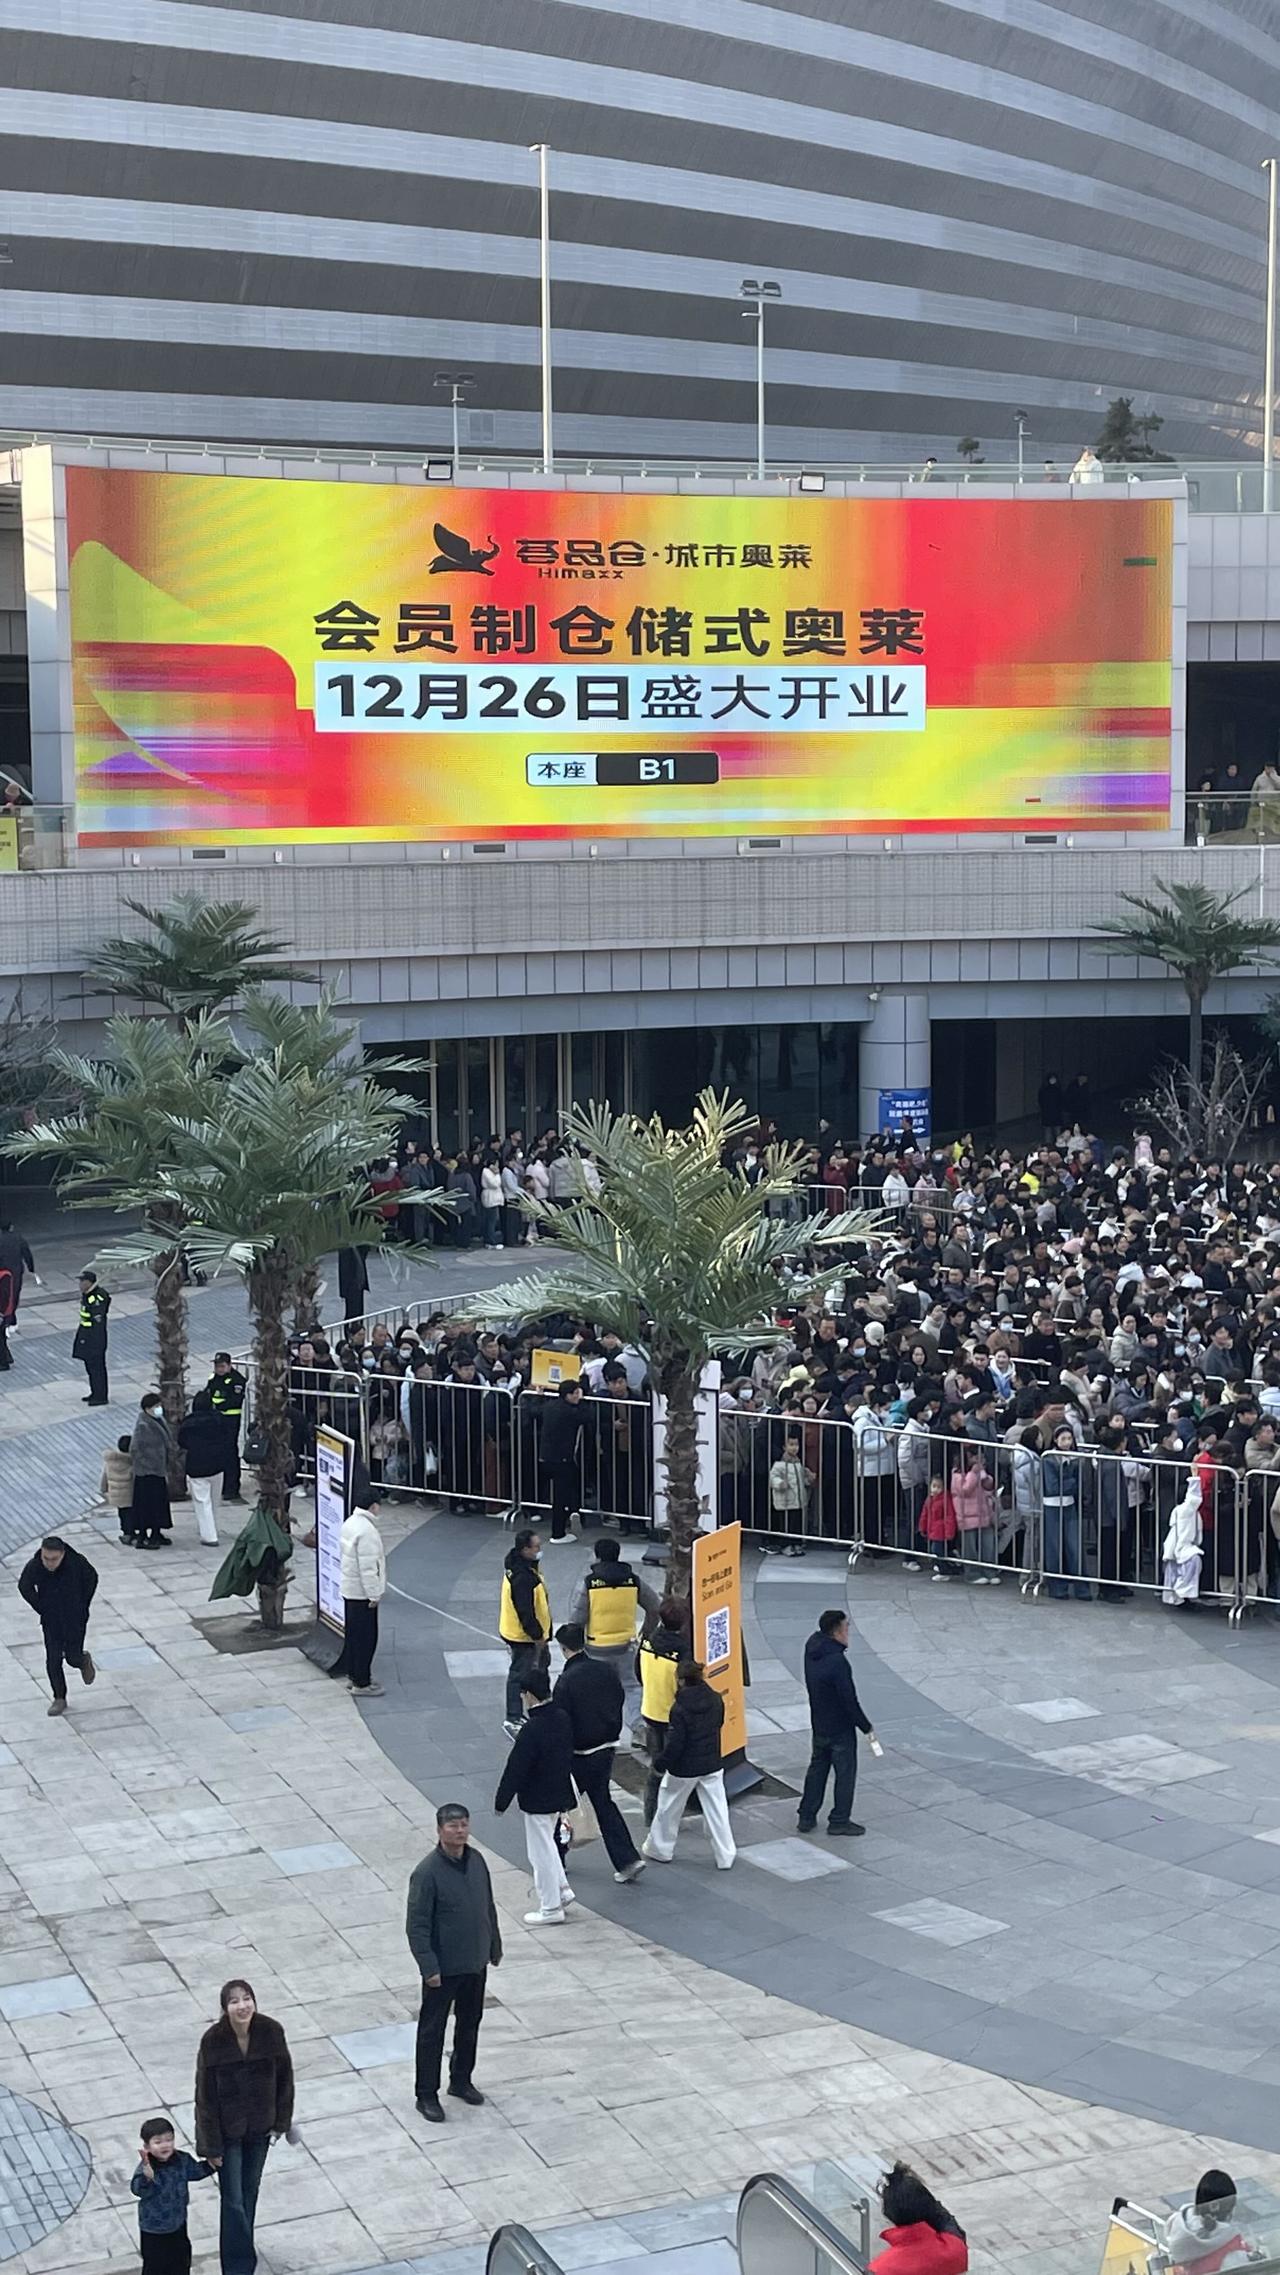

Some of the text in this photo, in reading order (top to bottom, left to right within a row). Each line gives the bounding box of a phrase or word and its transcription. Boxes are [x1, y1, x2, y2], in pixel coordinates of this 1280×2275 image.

[537, 567, 624, 579] Himaxx
[314, 601, 923, 656] 会员制仓储式奥莱
[328, 675, 907, 720] 12月26日盛大开业
[537, 757, 676, 781] 本座 B1
